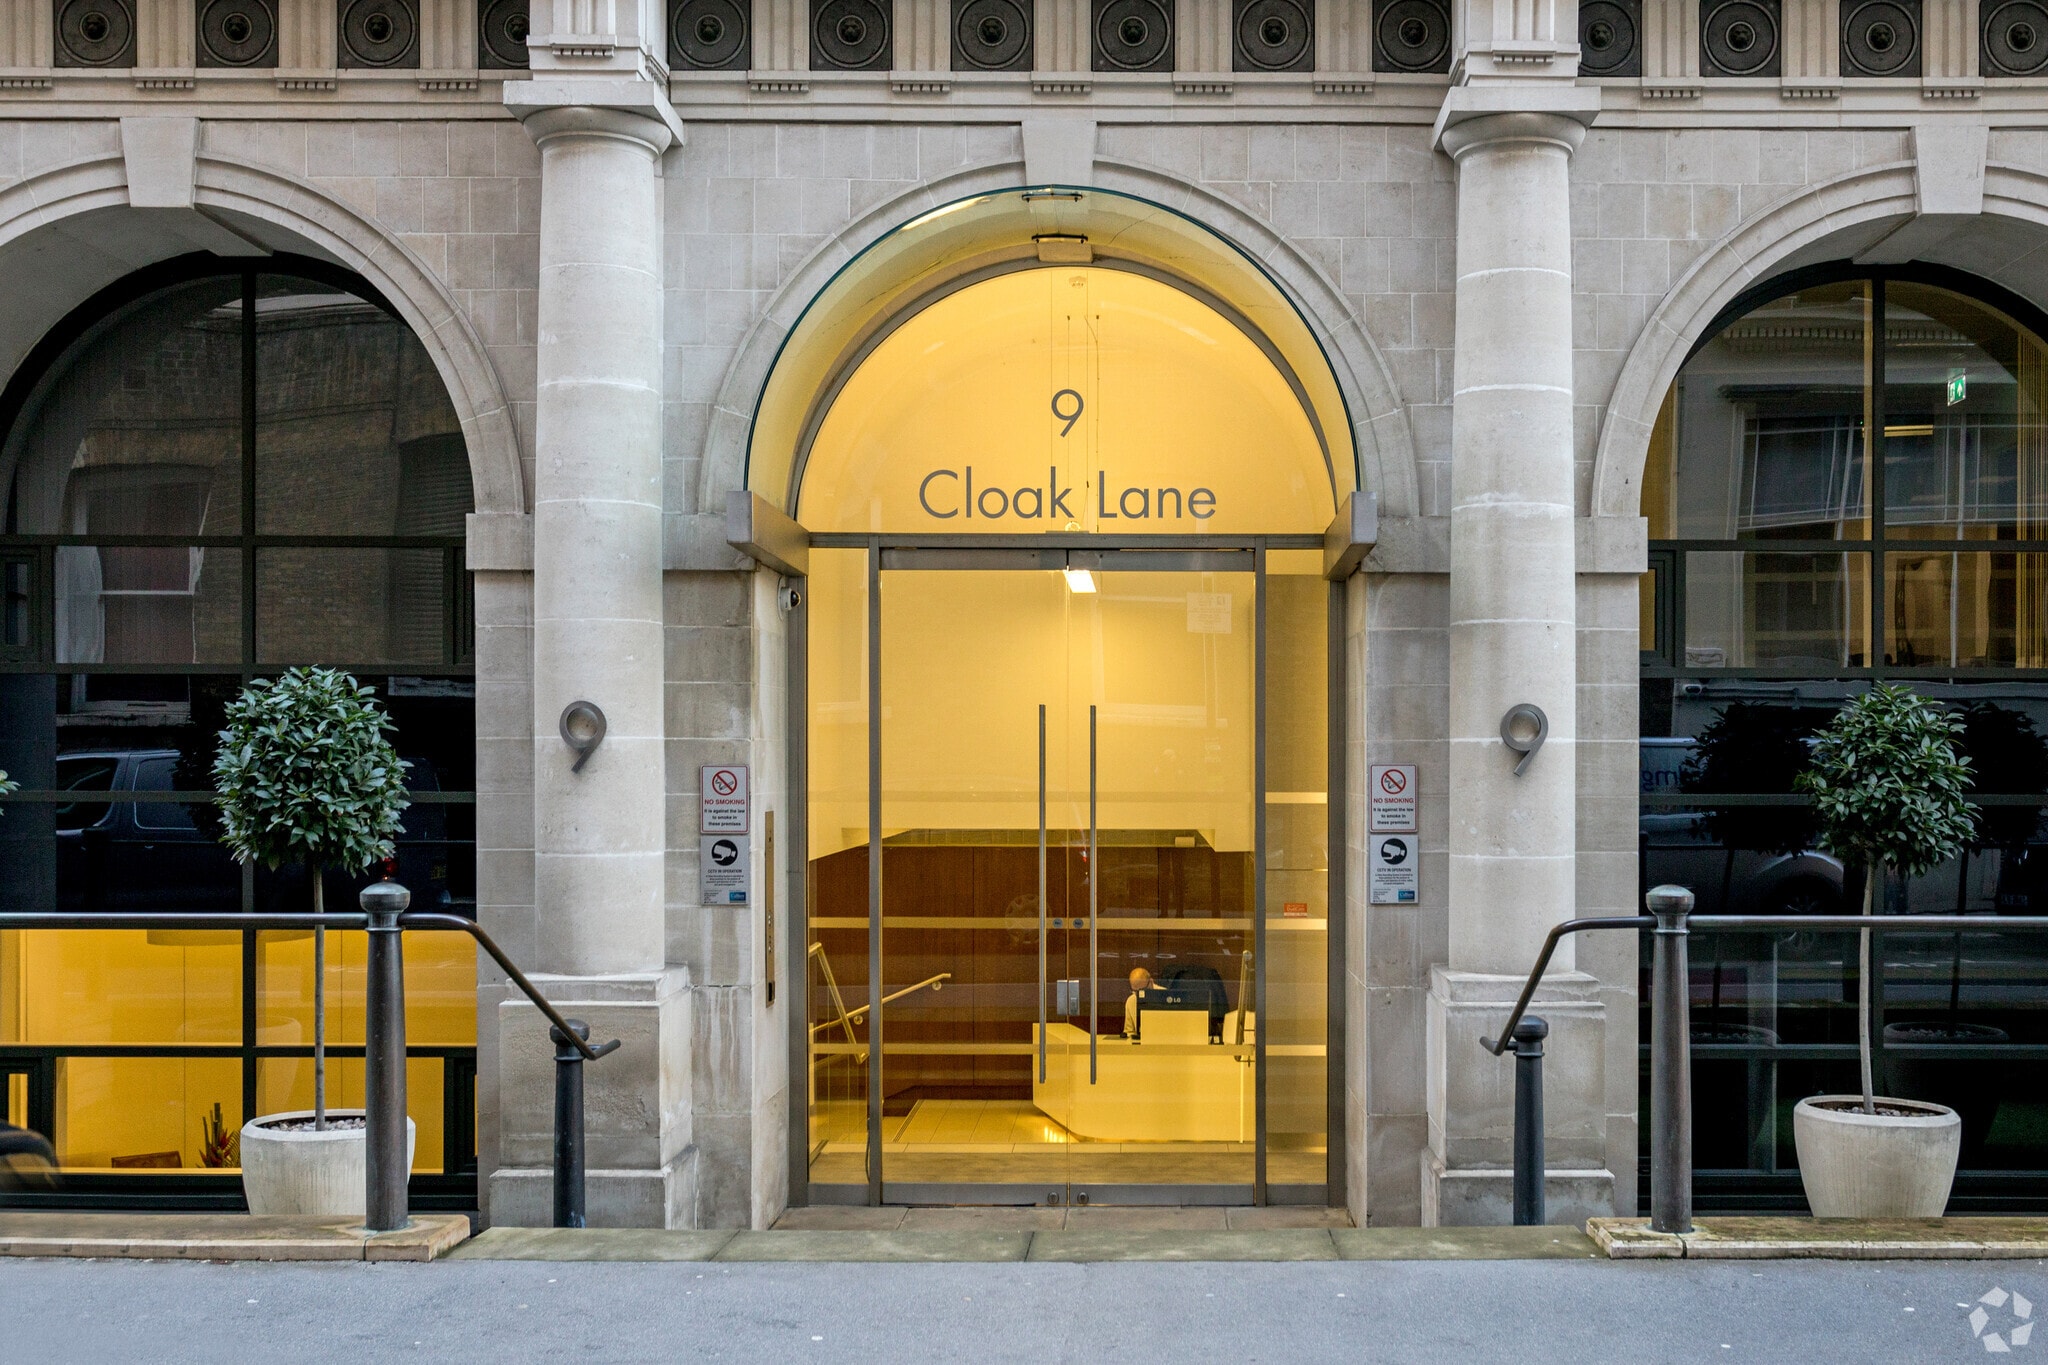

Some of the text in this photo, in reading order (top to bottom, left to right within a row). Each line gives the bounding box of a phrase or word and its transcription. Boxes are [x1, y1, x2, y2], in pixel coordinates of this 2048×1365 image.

[1051, 388, 1084, 438] 9
[919, 466, 1217, 519] Cloak Lane
[559, 700, 607, 773] 9
[1500, 703, 1549, 776] 9
